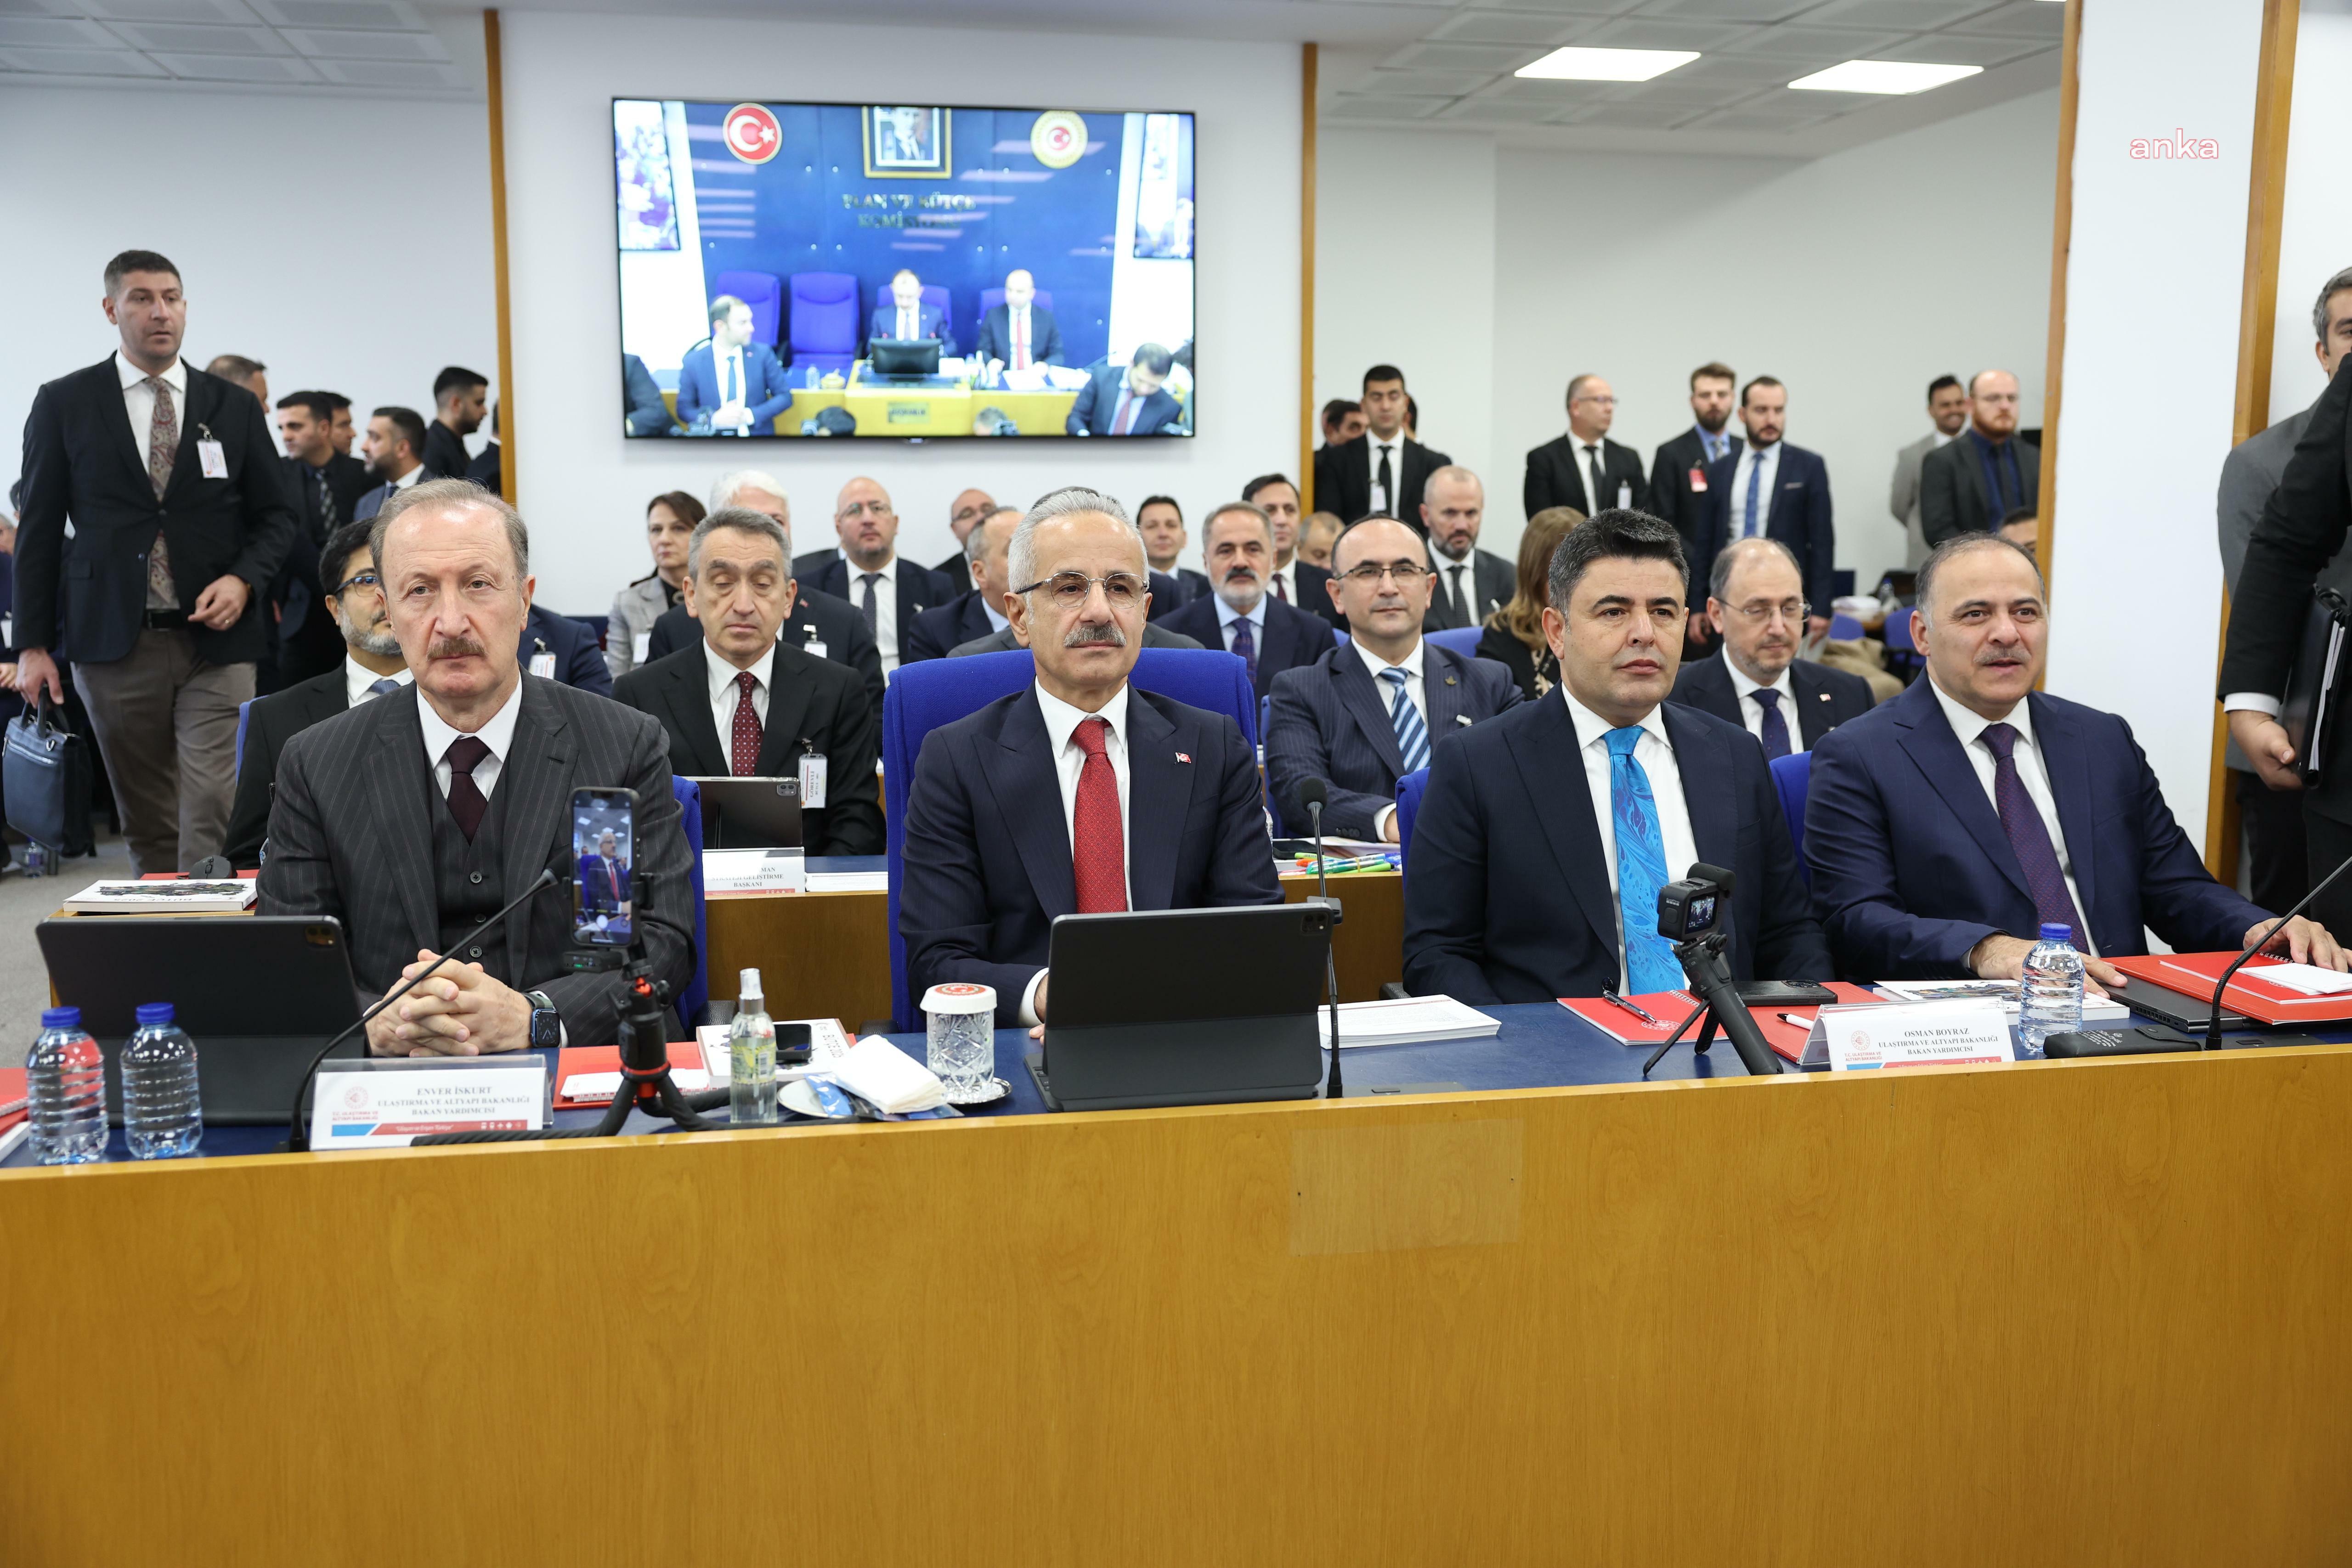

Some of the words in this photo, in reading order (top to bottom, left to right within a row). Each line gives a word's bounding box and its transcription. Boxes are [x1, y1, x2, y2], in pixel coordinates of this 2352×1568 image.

[1960, 1035, 1998, 1043] BAKANLIĞI
[417, 1088, 452, 1096] ENVER
[454, 1086, 492, 1095] İSKURT
[378, 1099, 428, 1107] ULAŞTIRMA
[482, 1095, 530, 1104] BAKANLIĞI
